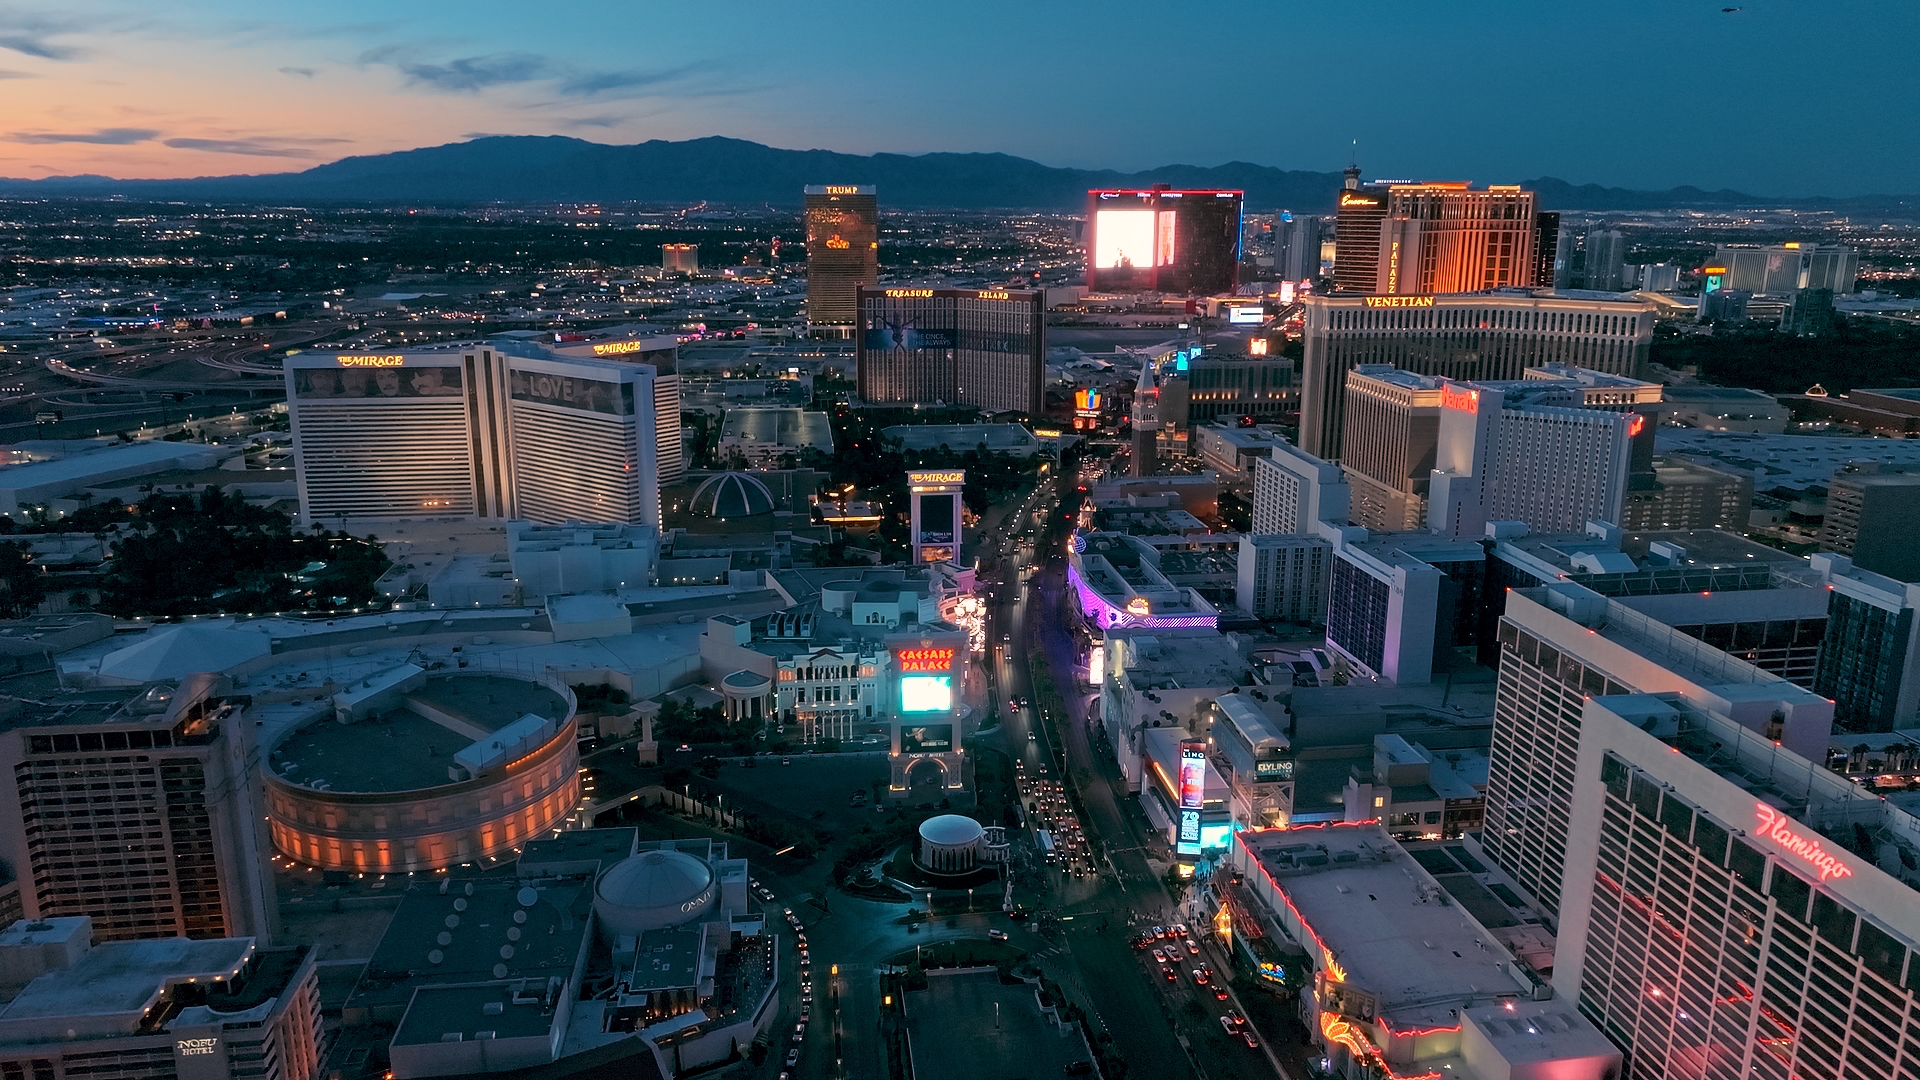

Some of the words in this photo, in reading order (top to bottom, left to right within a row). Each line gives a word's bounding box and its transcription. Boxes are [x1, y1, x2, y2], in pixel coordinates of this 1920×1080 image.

[826, 186, 858, 194] TRUMP
[1388, 242, 1399, 294] PALAZZ
[885, 289, 934, 298] TREASURE
[978, 291, 1009, 300] ISLAND
[1365, 296, 1434, 307] VENETIAN
[597, 341, 640, 355] MIRAGE
[343, 355, 404, 367] MIRAGE
[529, 375, 574, 402] LOVE
[915, 472, 963, 483] MIRAGE
[899, 649, 954, 660] CAESARS
[902, 660, 951, 671] PALACE
[1756, 803, 1852, 881] Flamingo
[177, 1038, 217, 1048] NOBU
[182, 1047, 214, 1055] HOTEL
